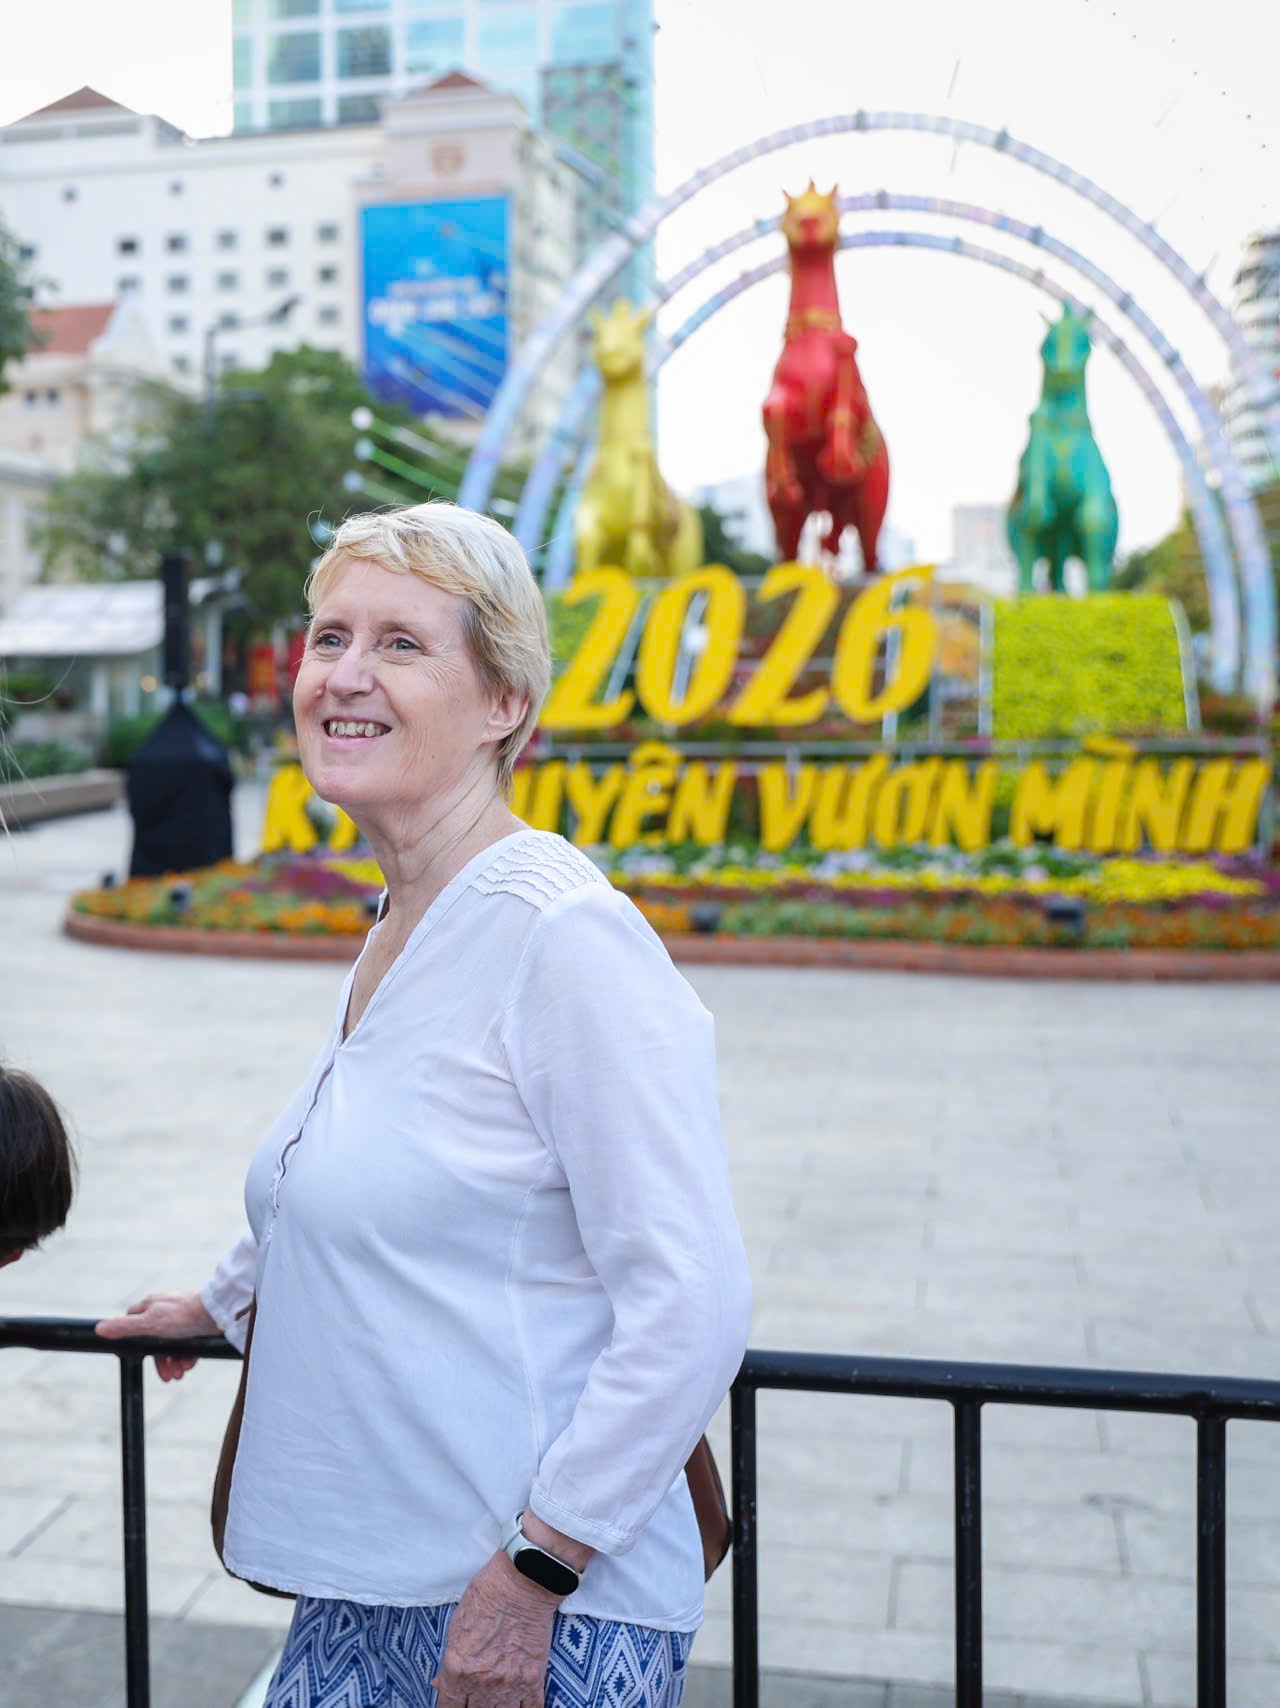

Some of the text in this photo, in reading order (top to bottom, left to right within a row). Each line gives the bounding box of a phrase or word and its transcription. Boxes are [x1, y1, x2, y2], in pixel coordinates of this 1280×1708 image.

[538, 561, 941, 730] 2026
[260, 763, 358, 852] K
[510, 740, 737, 850] UYÊN
